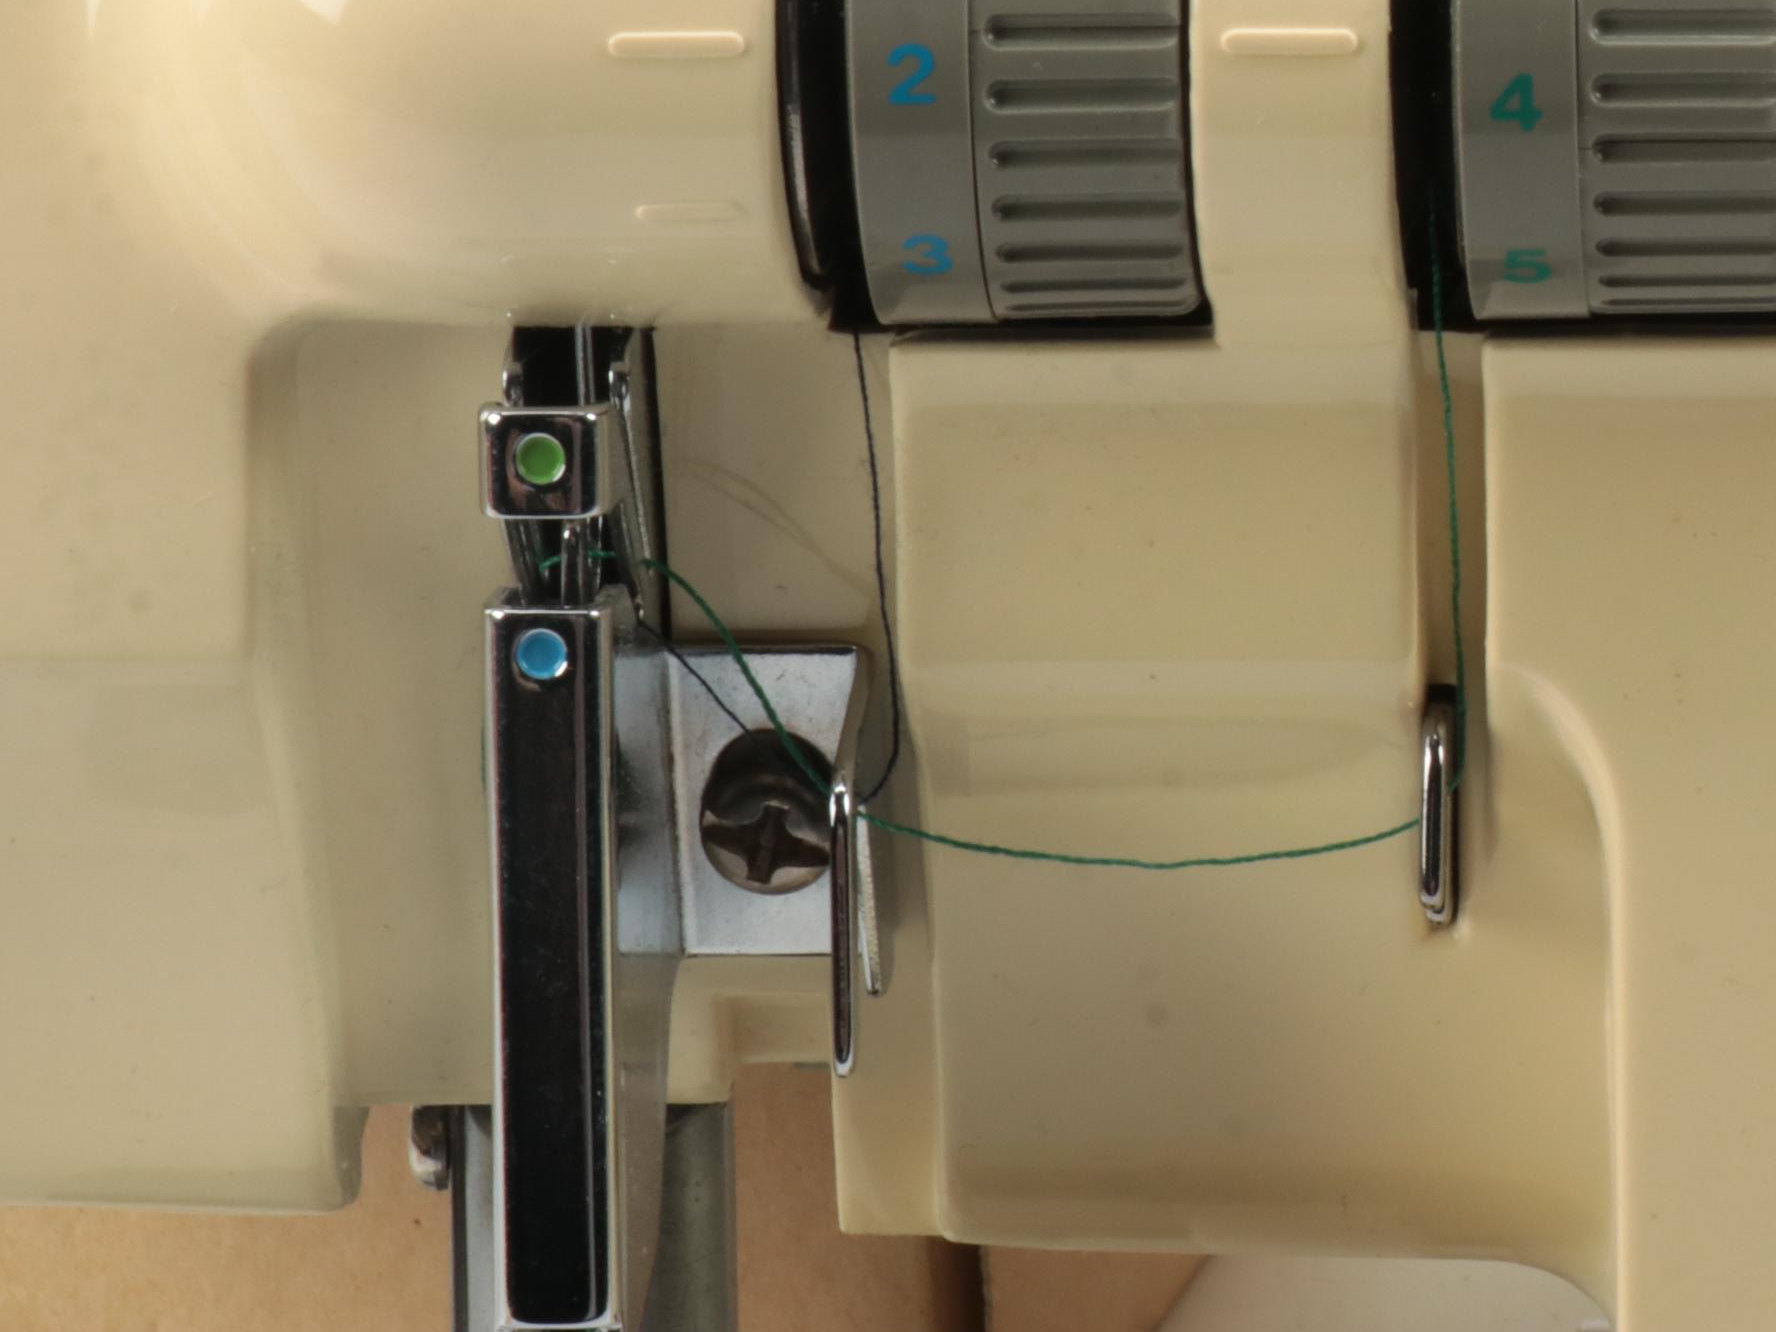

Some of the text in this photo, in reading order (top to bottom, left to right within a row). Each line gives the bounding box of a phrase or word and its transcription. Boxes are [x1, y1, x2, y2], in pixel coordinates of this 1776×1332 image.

[887, 42, 938, 106] 2
[1489, 72, 1543, 132] 4
[901, 233, 954, 277] 3
[1504, 248, 1552, 285] 5
